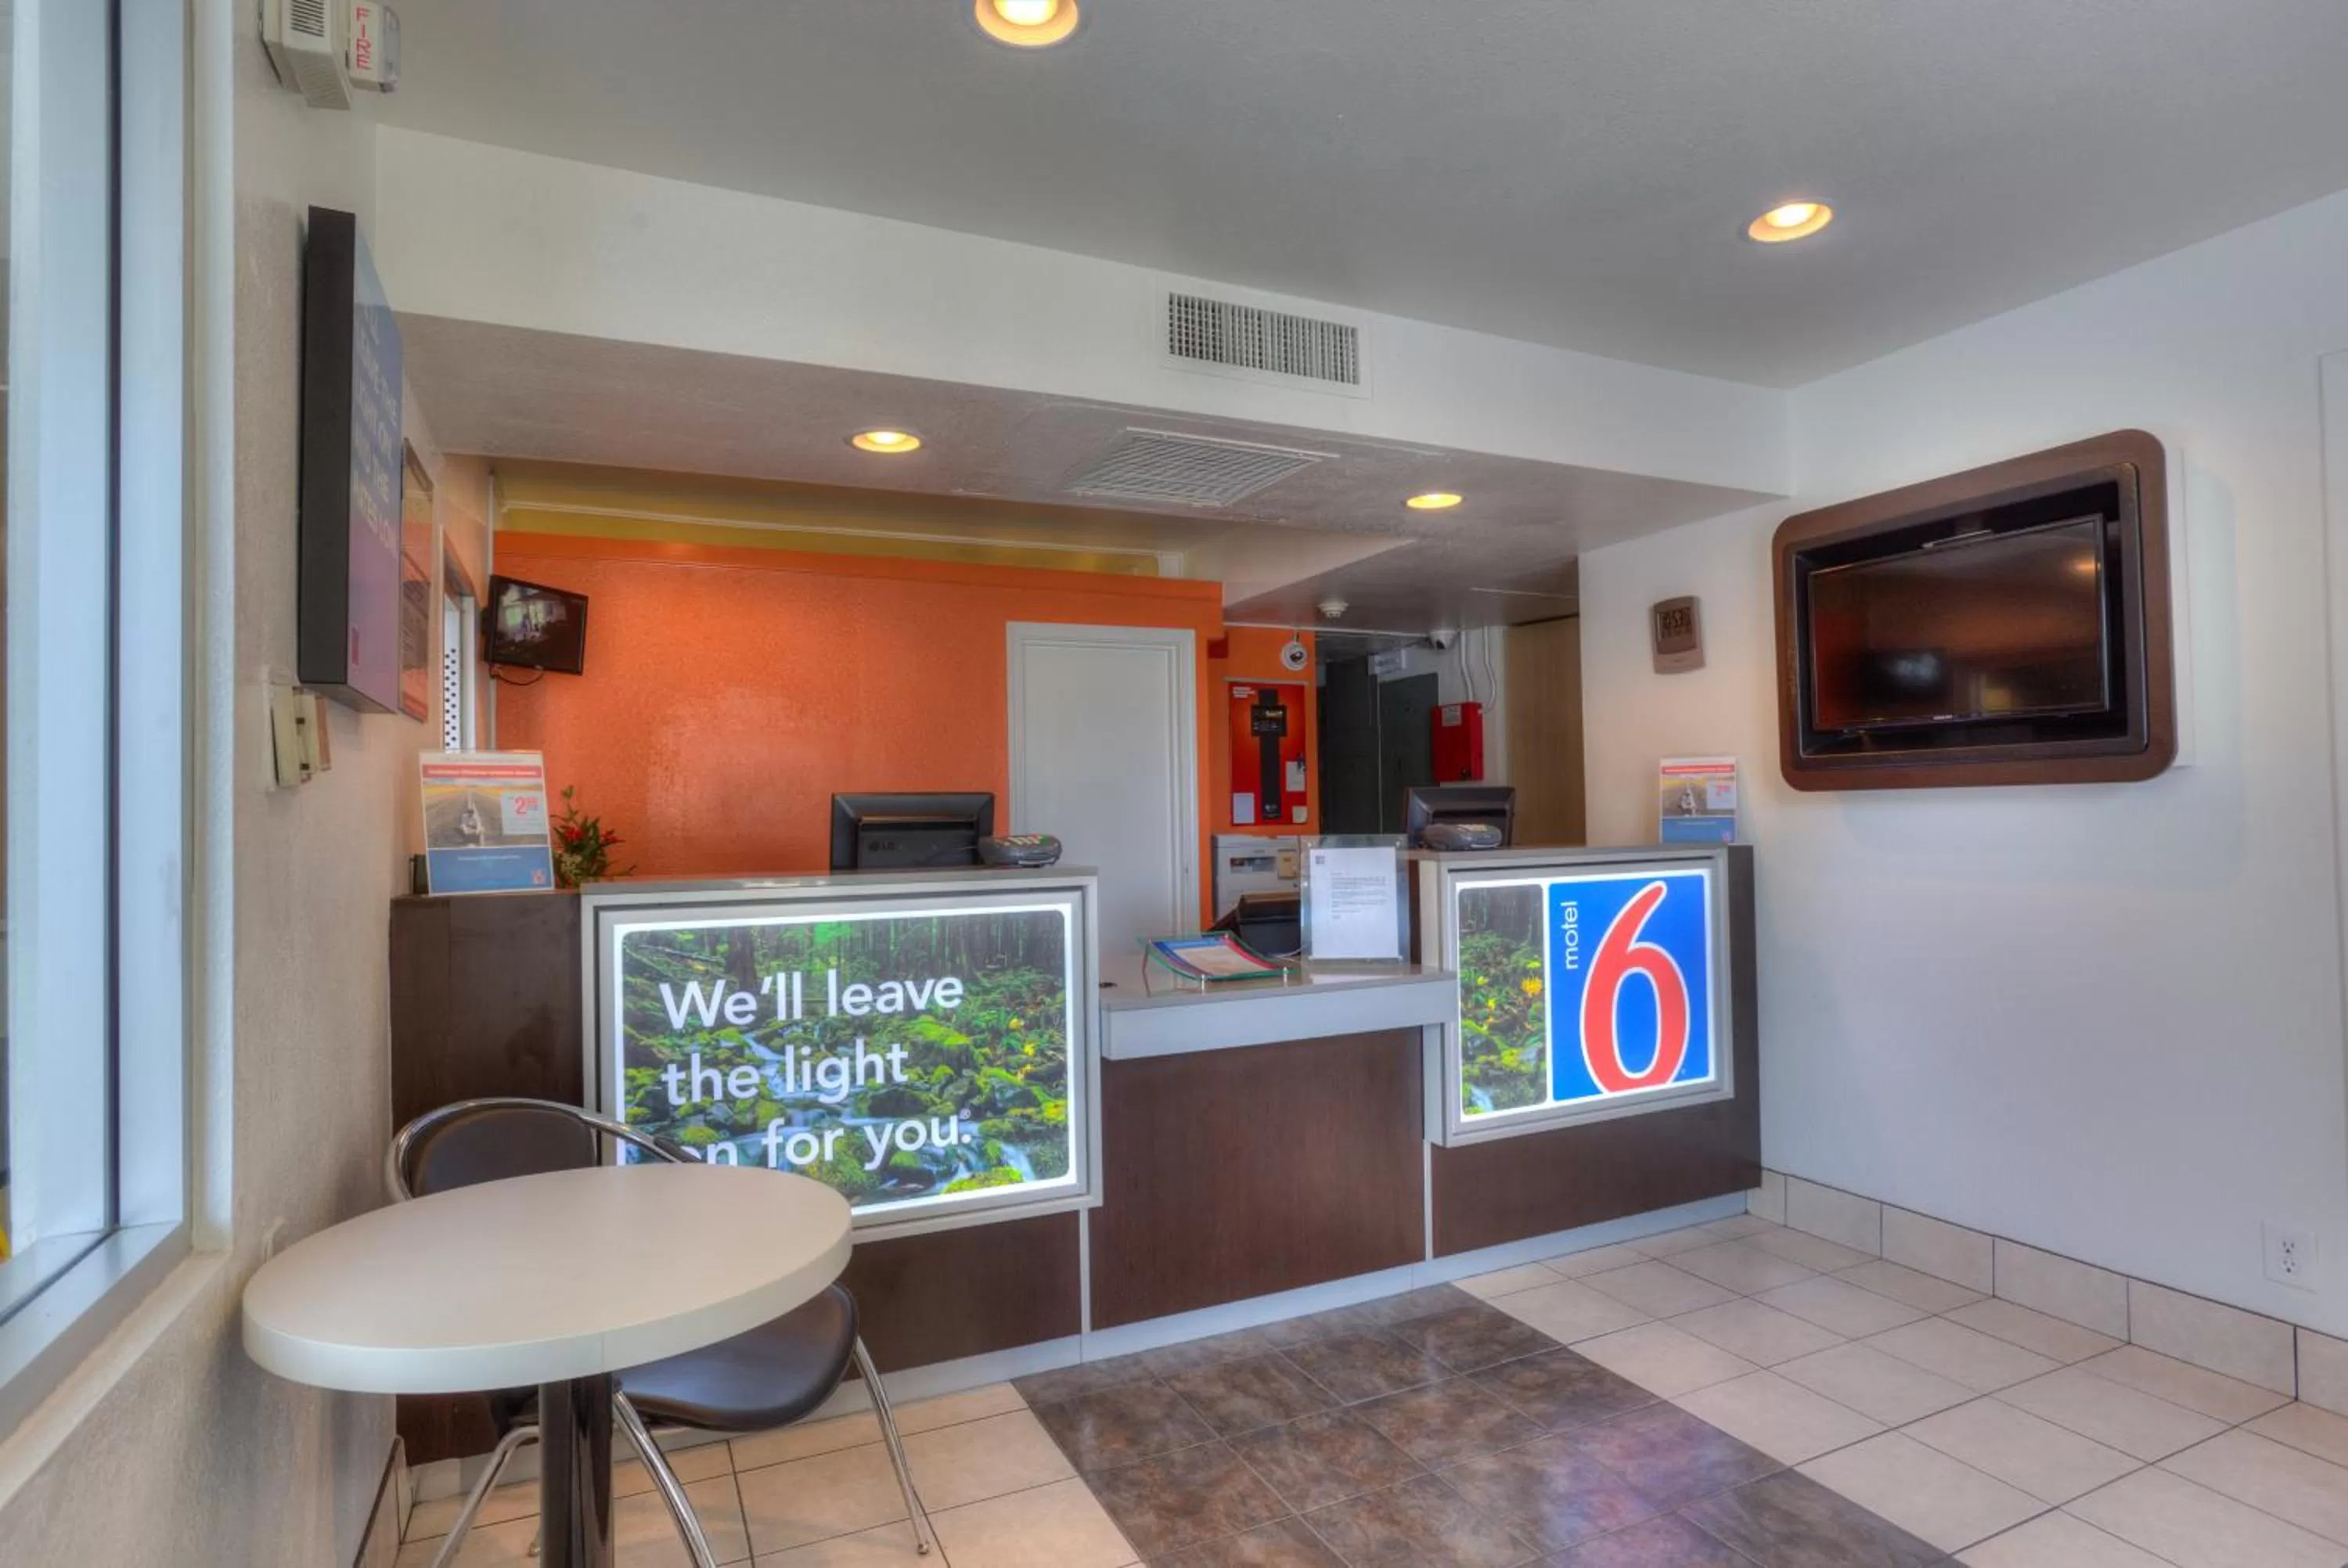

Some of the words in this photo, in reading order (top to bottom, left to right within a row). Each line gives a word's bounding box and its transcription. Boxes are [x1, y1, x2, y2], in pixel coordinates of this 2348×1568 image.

[356, 7, 372, 70] FIRE
[1560, 901, 1579, 970] motel
[659, 971, 802, 1030] We'll
[826, 969, 963, 1017] leave
[1579, 880, 1691, 1095] 6
[661, 1052, 761, 1106] the
[785, 1038, 909, 1104] light
[761, 1117, 844, 1168] for
[863, 1113, 973, 1171] you.
